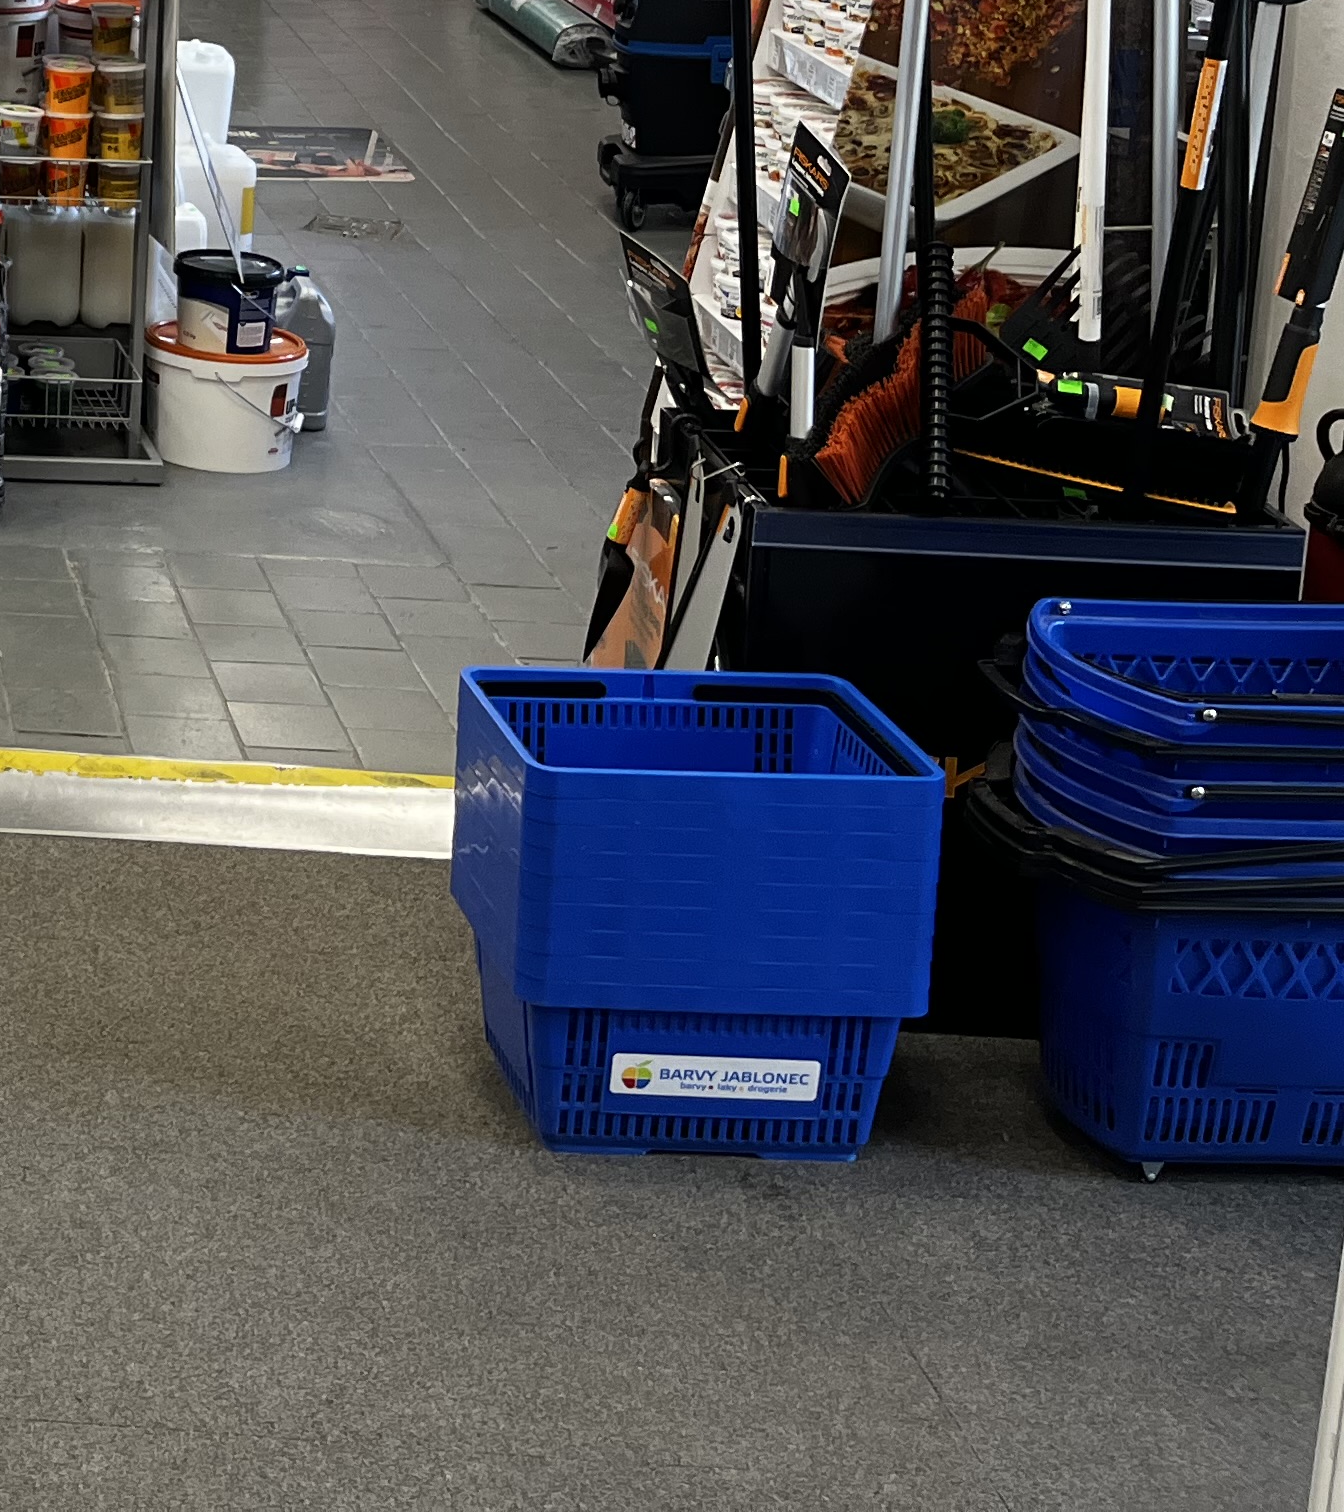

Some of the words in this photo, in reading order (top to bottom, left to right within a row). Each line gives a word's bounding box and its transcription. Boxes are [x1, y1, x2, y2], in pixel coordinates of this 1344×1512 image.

[659, 1068, 717, 1082] BARVY
[721, 1071, 810, 1086] JABLONEC
[680, 1082, 707, 1092] barvy
[717, 1083, 737, 1093] laky
[748, 1084, 788, 1094] drogerie
